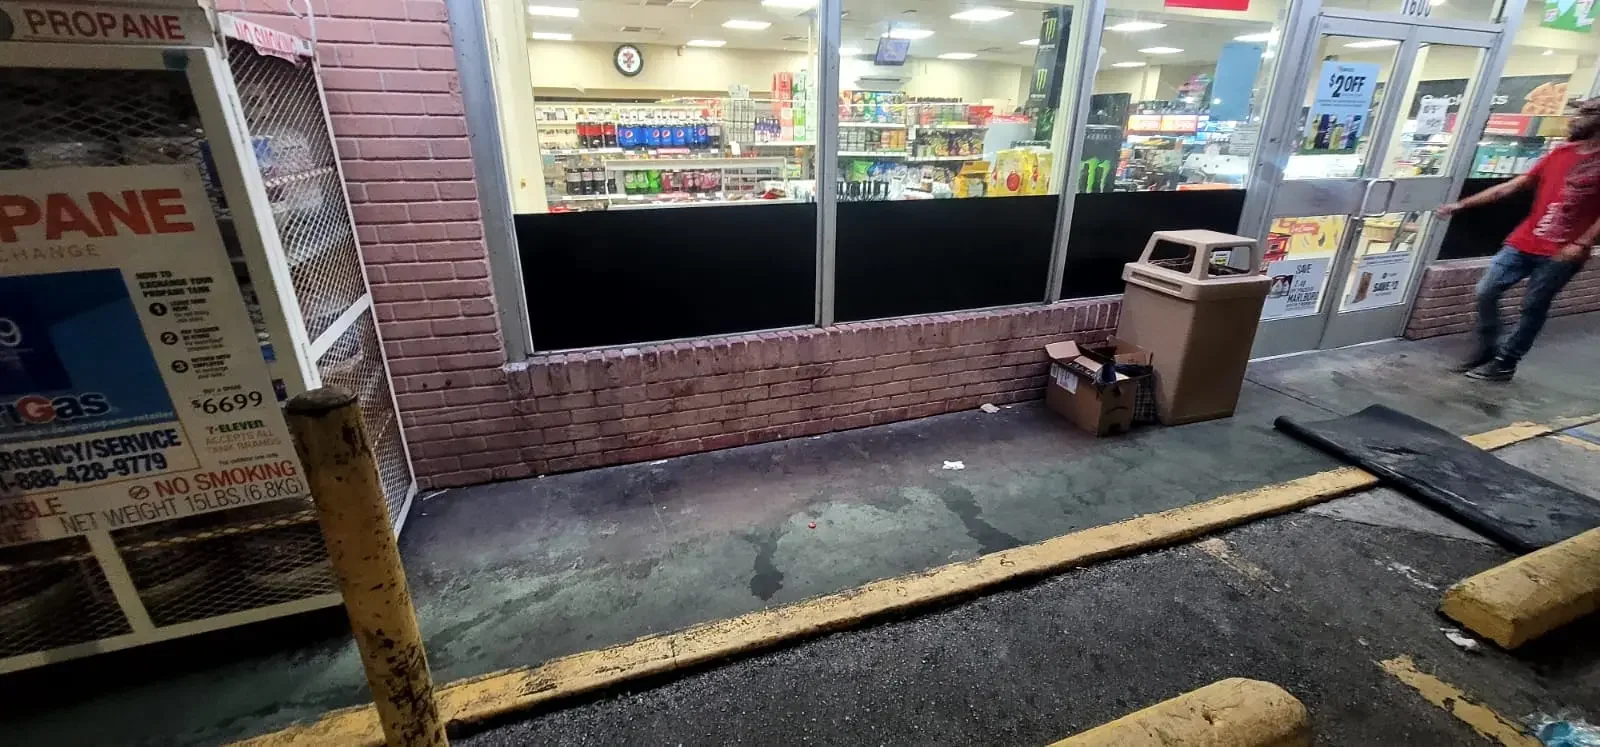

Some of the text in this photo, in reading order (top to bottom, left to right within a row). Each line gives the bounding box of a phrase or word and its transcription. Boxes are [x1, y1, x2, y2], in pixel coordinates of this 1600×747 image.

[23, 8, 185, 40] PROPANE
[0, 188, 195, 243] PANE
[154, 460, 297, 498] NO SMOKING
[59, 512, 98, 534] NET
[103, 497, 179, 528] WEIGHT
